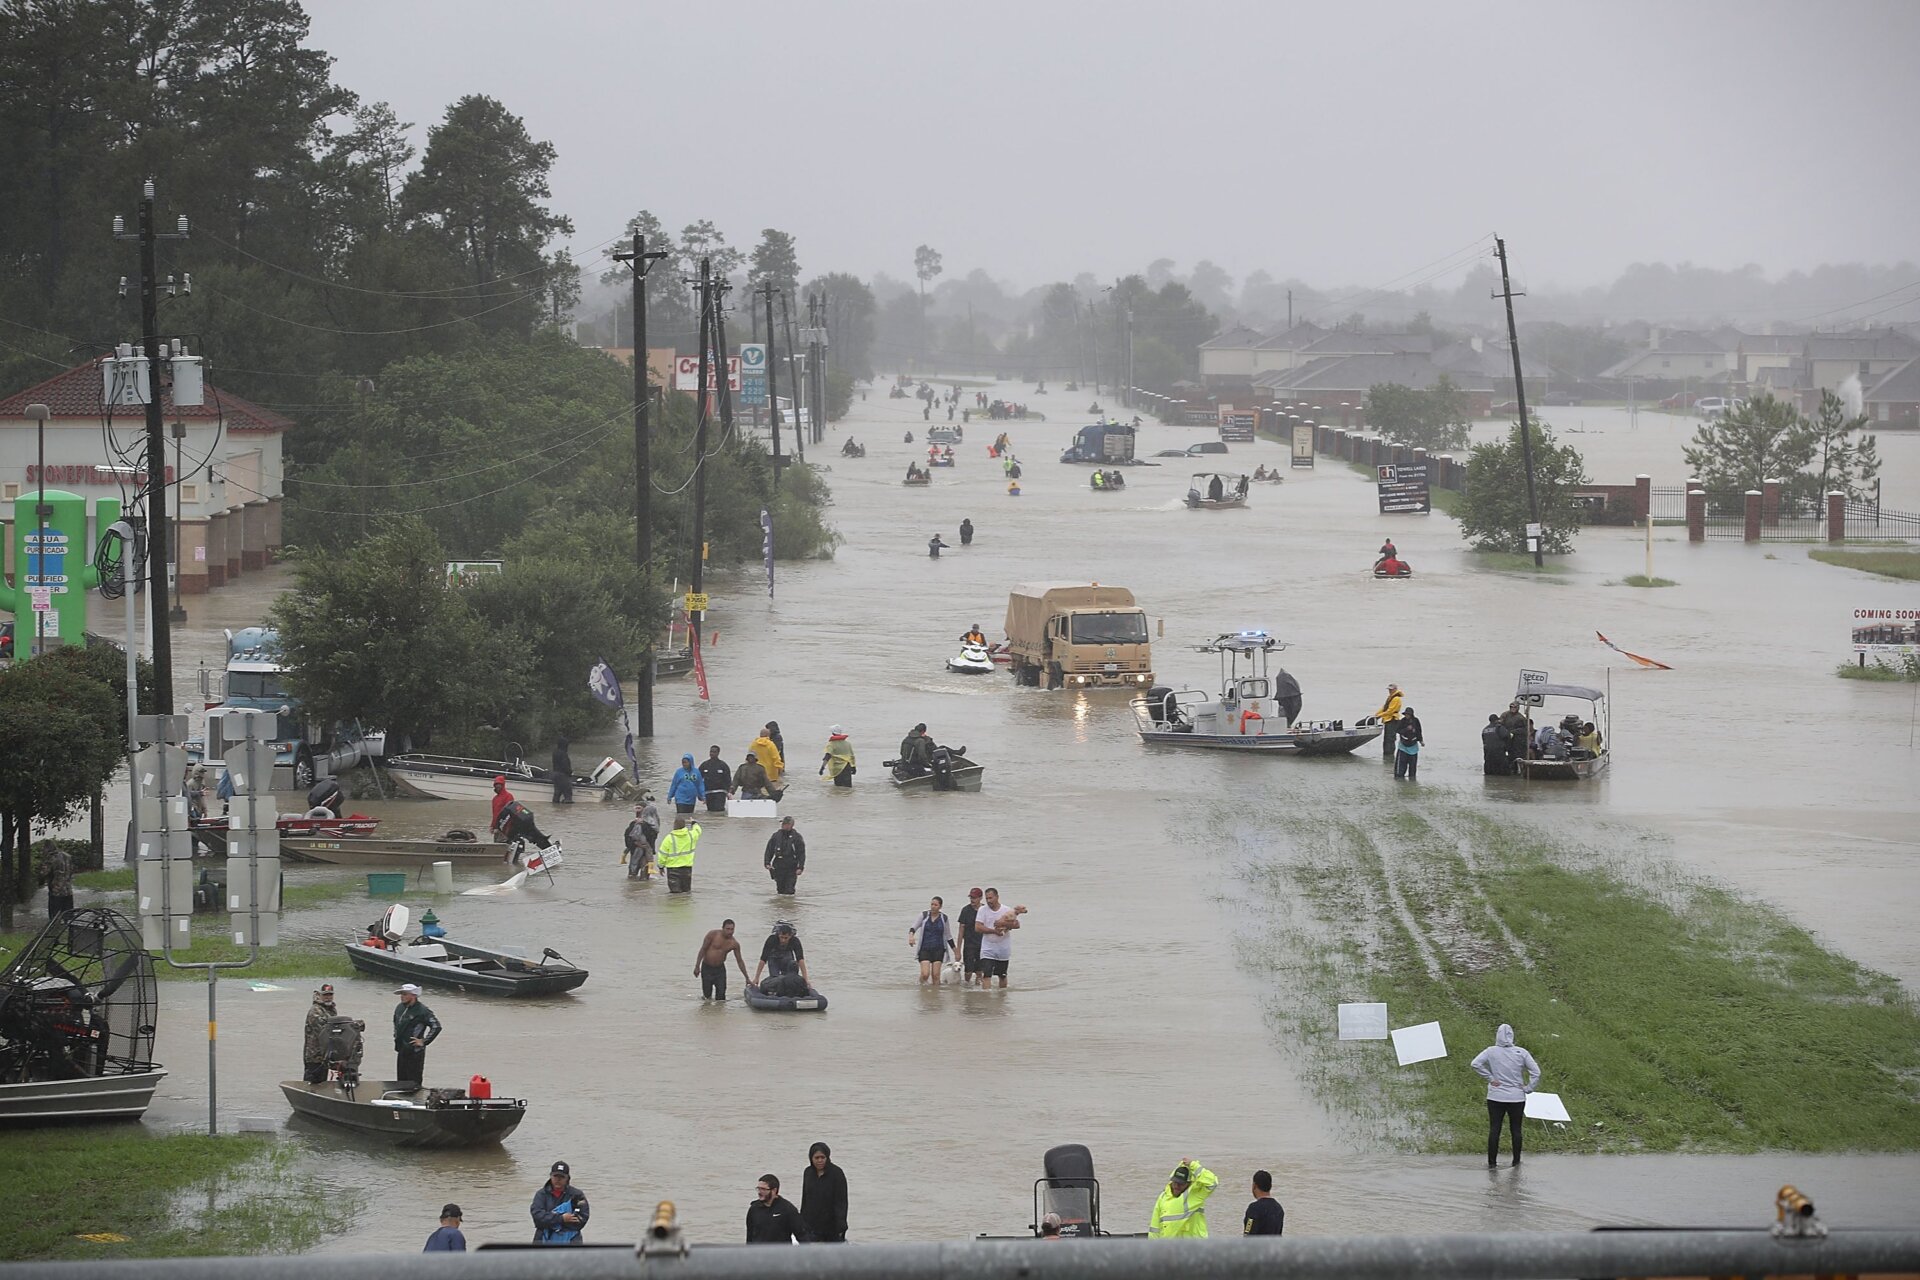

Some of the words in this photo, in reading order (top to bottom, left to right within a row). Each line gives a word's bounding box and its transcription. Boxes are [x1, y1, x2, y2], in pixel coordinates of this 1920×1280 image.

[680, 358, 737, 374] Crsl
[1854, 609, 1892, 619] COMING
[1895, 610, 1920, 619] SOON
[1523, 673, 1545, 682] SPEED
[435, 846, 487, 855] ALUMACRAFT
